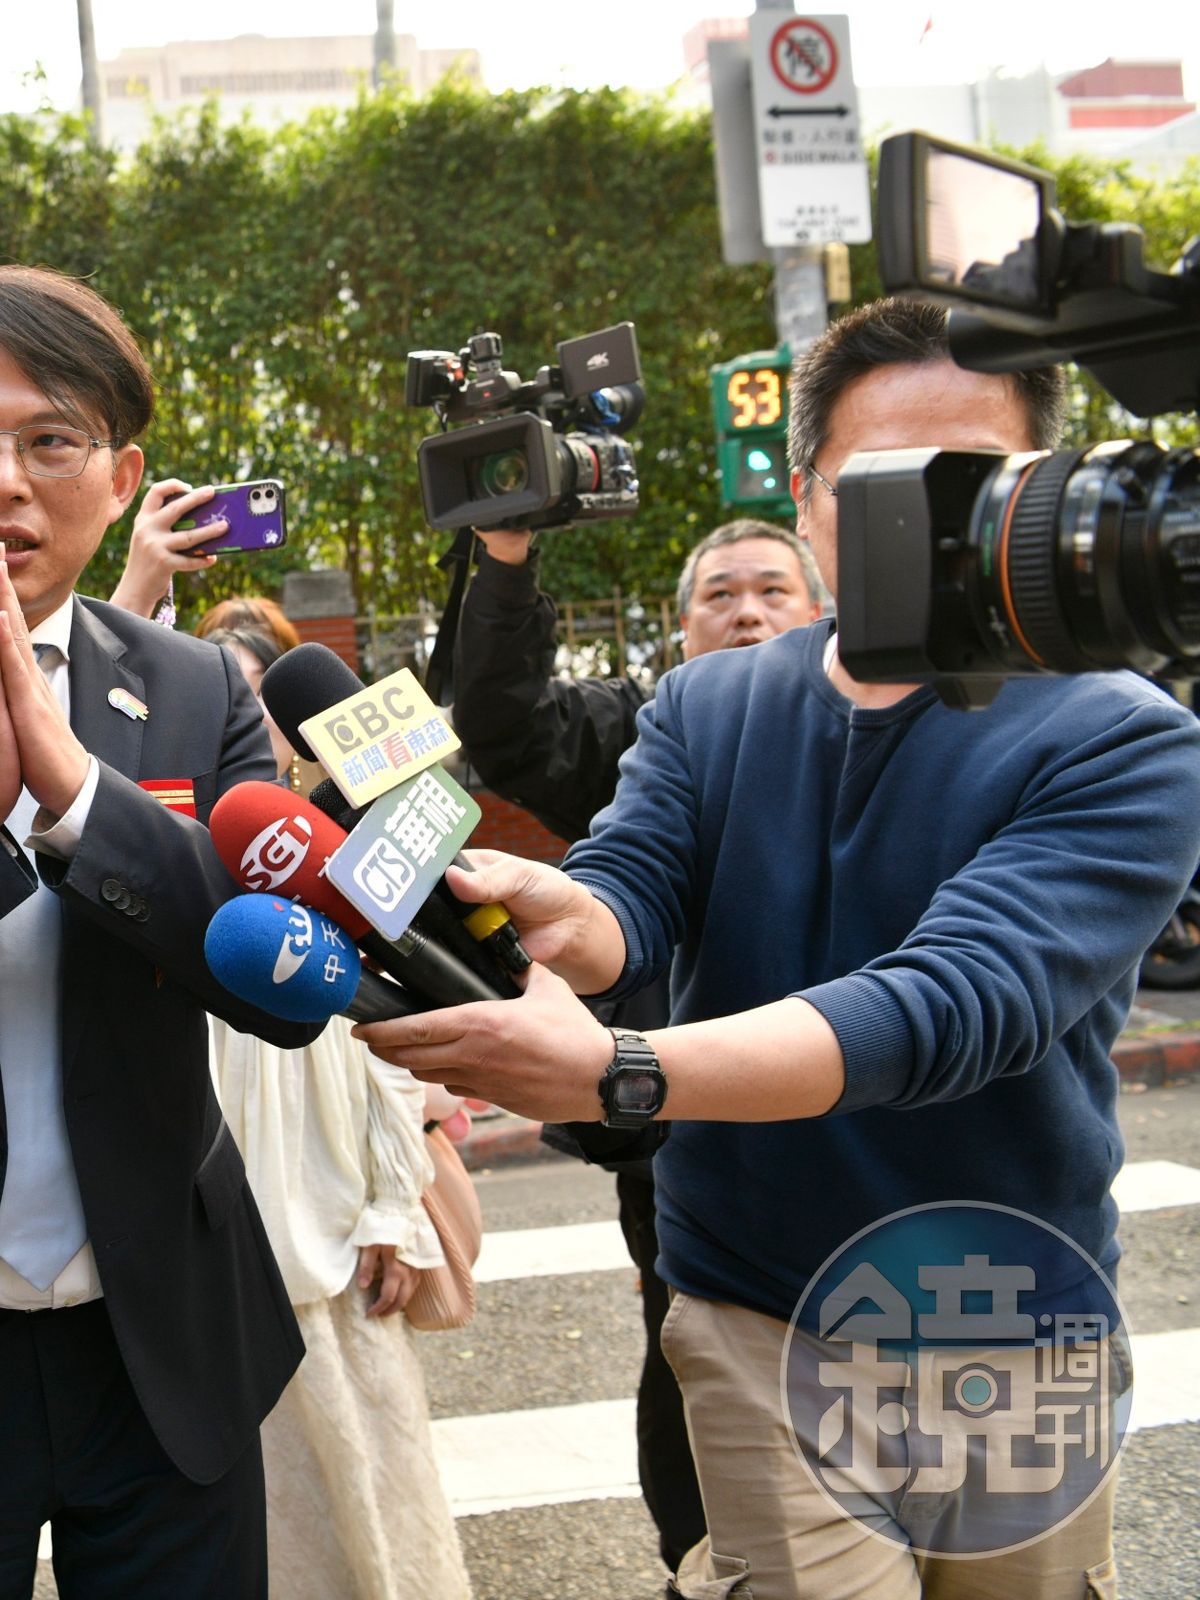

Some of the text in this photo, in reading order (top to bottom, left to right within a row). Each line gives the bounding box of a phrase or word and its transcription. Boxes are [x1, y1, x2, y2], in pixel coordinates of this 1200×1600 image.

[727, 369, 782, 428] 53
[341, 716, 450, 788] 新聞看東森
[354, 769, 468, 912] CTS 華視
[322, 920, 346, 984] 中天
